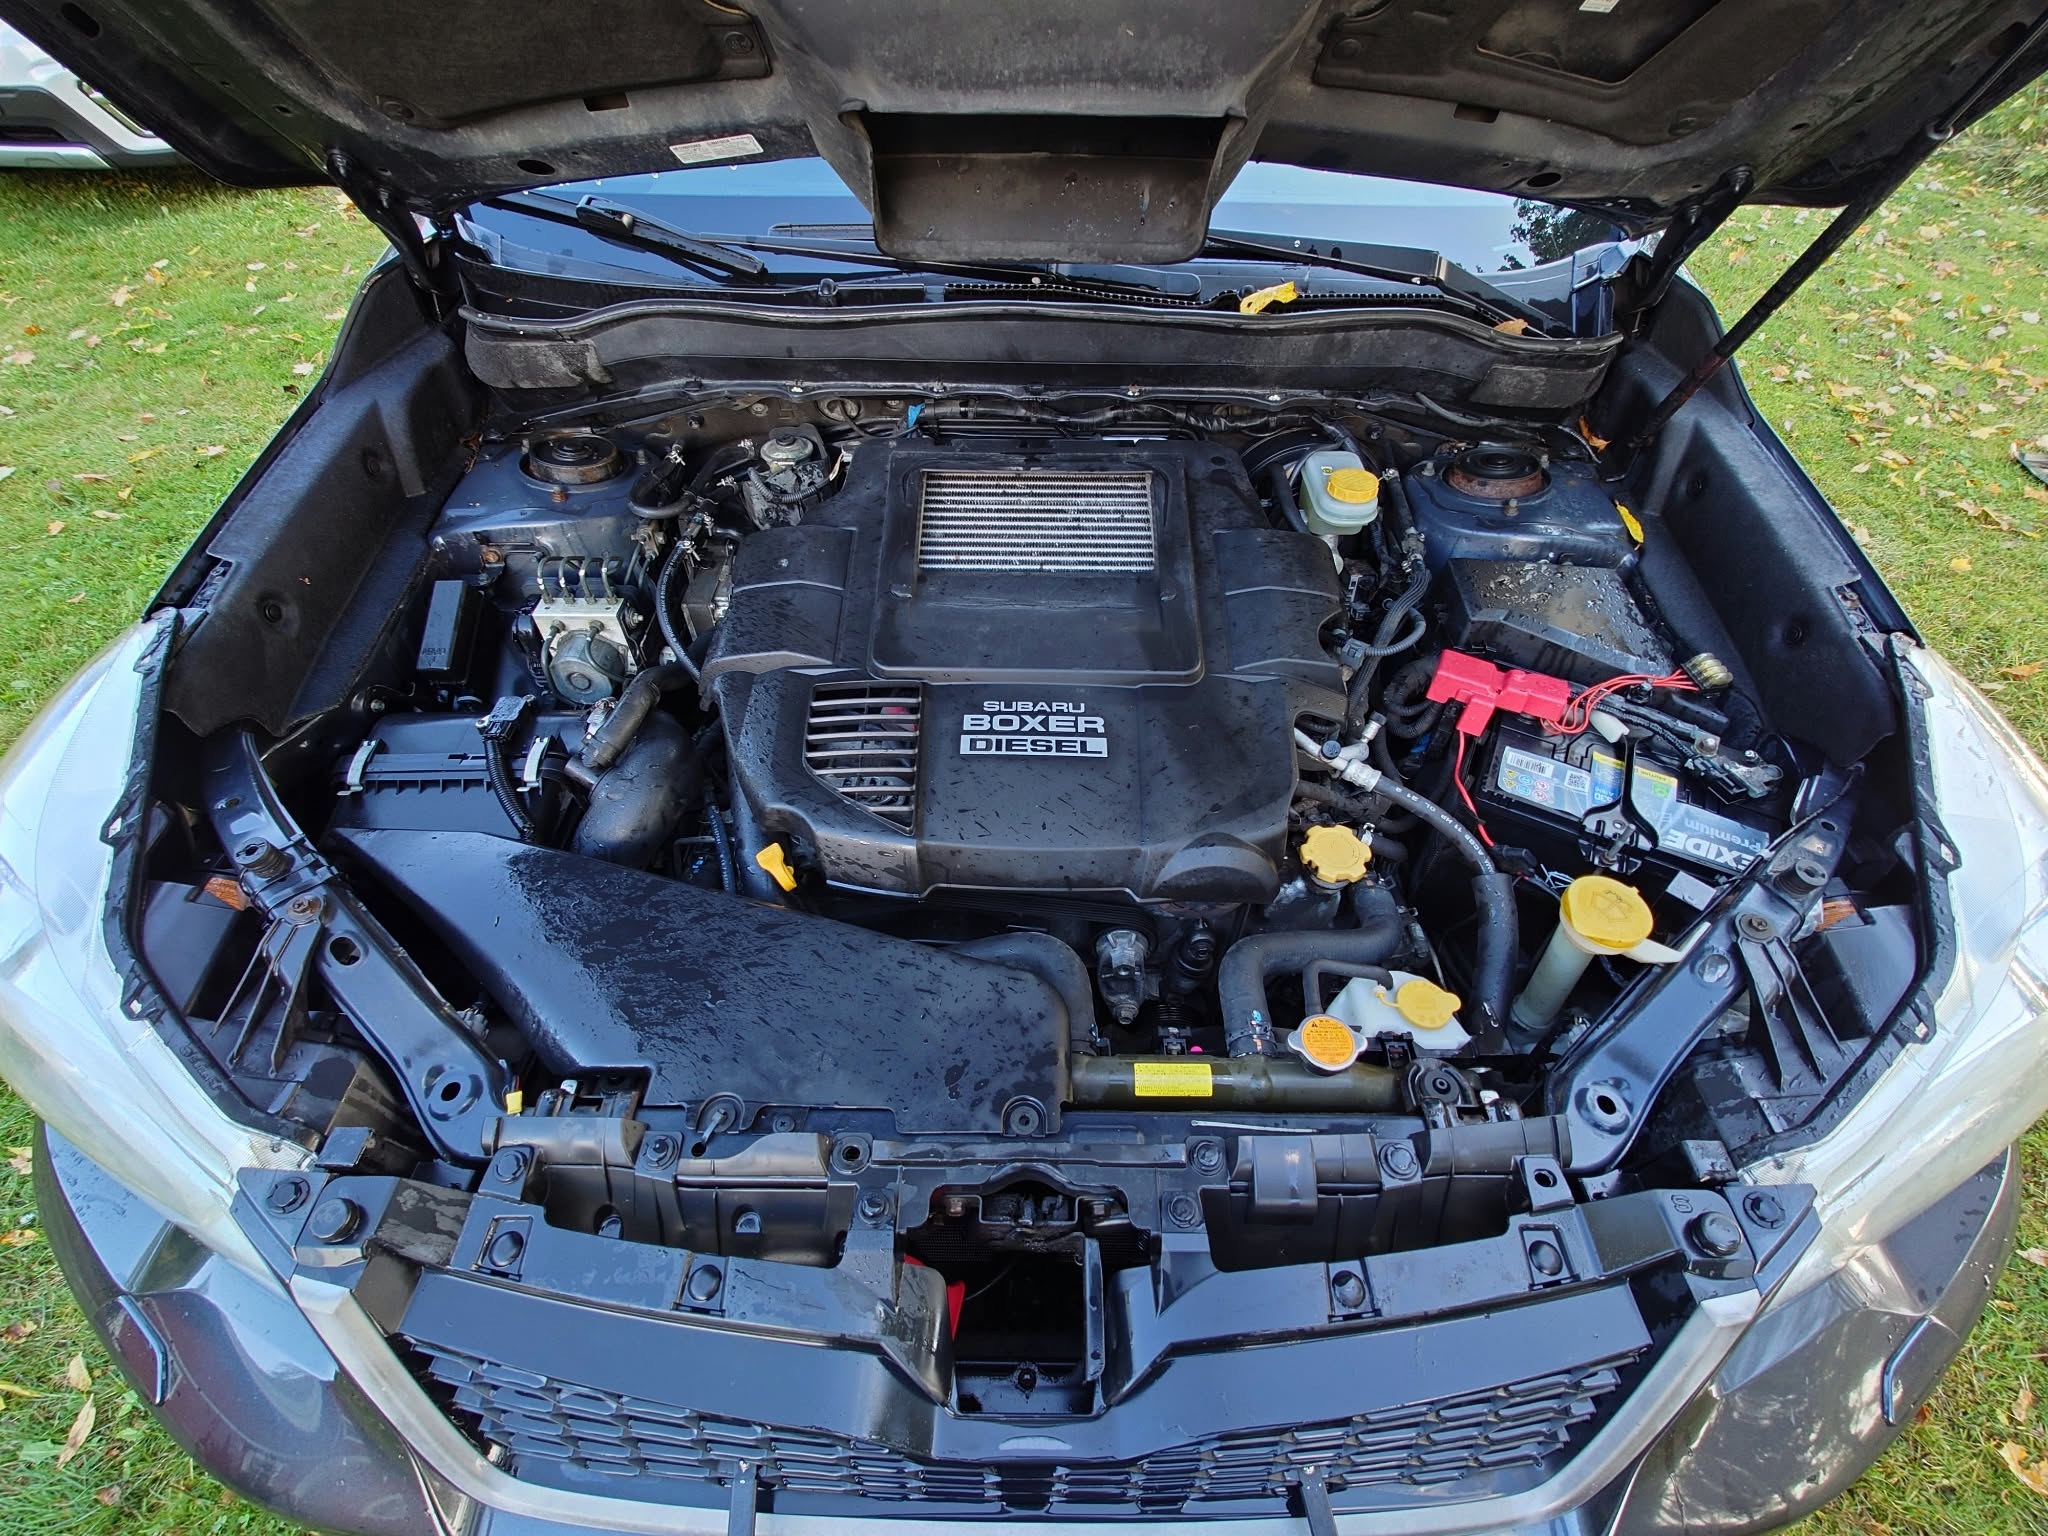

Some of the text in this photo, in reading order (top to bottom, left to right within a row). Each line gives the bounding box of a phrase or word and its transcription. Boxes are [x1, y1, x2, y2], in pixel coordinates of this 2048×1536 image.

[983, 700, 1085, 713] SUBARU
[962, 714, 1105, 733] BOXER
[968, 737, 1104, 755] DIESEL
[1683, 817, 1762, 853] Premium
[1662, 828, 1755, 871] EXIDE
